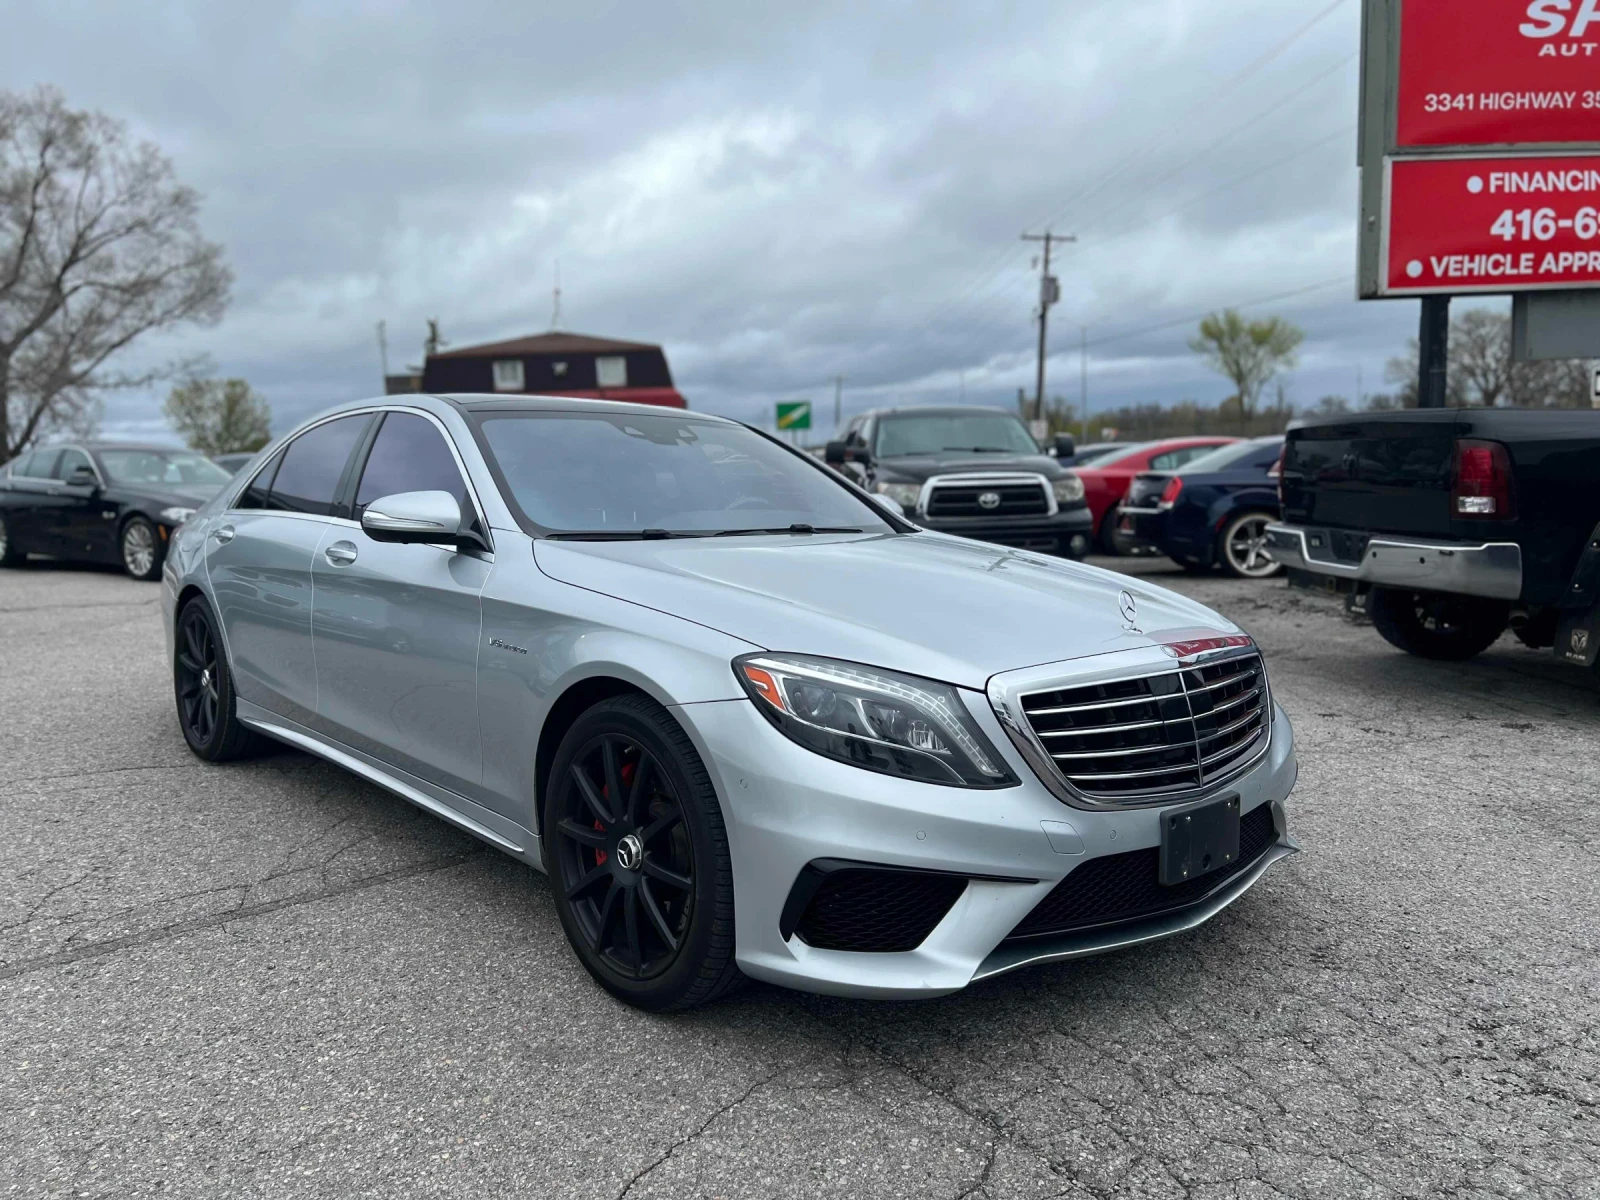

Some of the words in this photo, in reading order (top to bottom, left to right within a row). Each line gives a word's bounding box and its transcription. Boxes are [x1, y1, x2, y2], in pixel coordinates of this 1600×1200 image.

[1538, 43, 1598, 56] AUT
[1424, 93, 1474, 111] 3341
[1479, 92, 1576, 110] HIGHWAY
[1490, 207, 1600, 241] 416-6
[1430, 253, 1534, 278] VEHICLE
